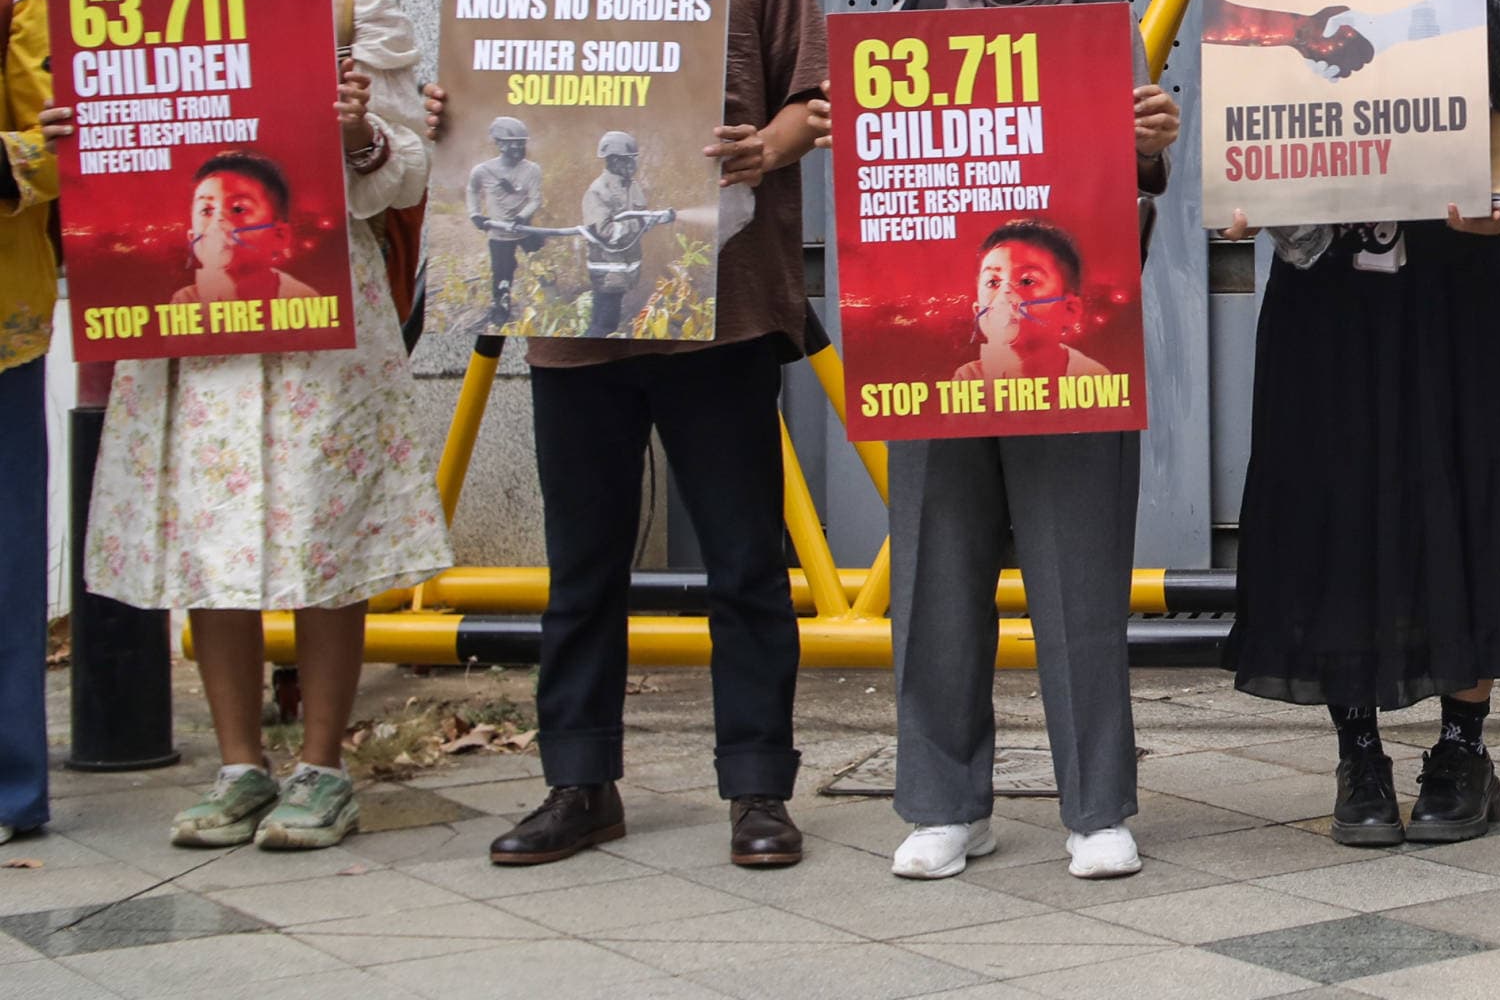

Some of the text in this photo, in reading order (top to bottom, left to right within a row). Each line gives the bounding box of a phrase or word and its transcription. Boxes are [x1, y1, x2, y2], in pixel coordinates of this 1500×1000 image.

[72, 43, 251, 97] CHILDREN
[473, 39, 681, 73] NEITHER SHOULD
[853, 32, 1041, 109] 63.711
[507, 74, 651, 107] SOLIDARITY
[76, 95, 231, 125] SUFFERING FROM
[1225, 96, 1468, 142] NEITHER SHOULD
[79, 118, 259, 149] ACUTE RESPIRATORY
[855, 106, 1044, 161] CHILDREN
[80, 148, 171, 174] INFECTION
[858, 160, 1021, 191] SUFFERING FROM
[1225, 139, 1392, 182] SOLIDARITY
[859, 185, 1051, 217] ACUTE RESPIRATORY
[860, 215, 957, 243] INFECTION
[84, 296, 339, 340] STOP THE FIRE NOW!
[861, 373, 1131, 417] STOP THE FIRE NOW!
